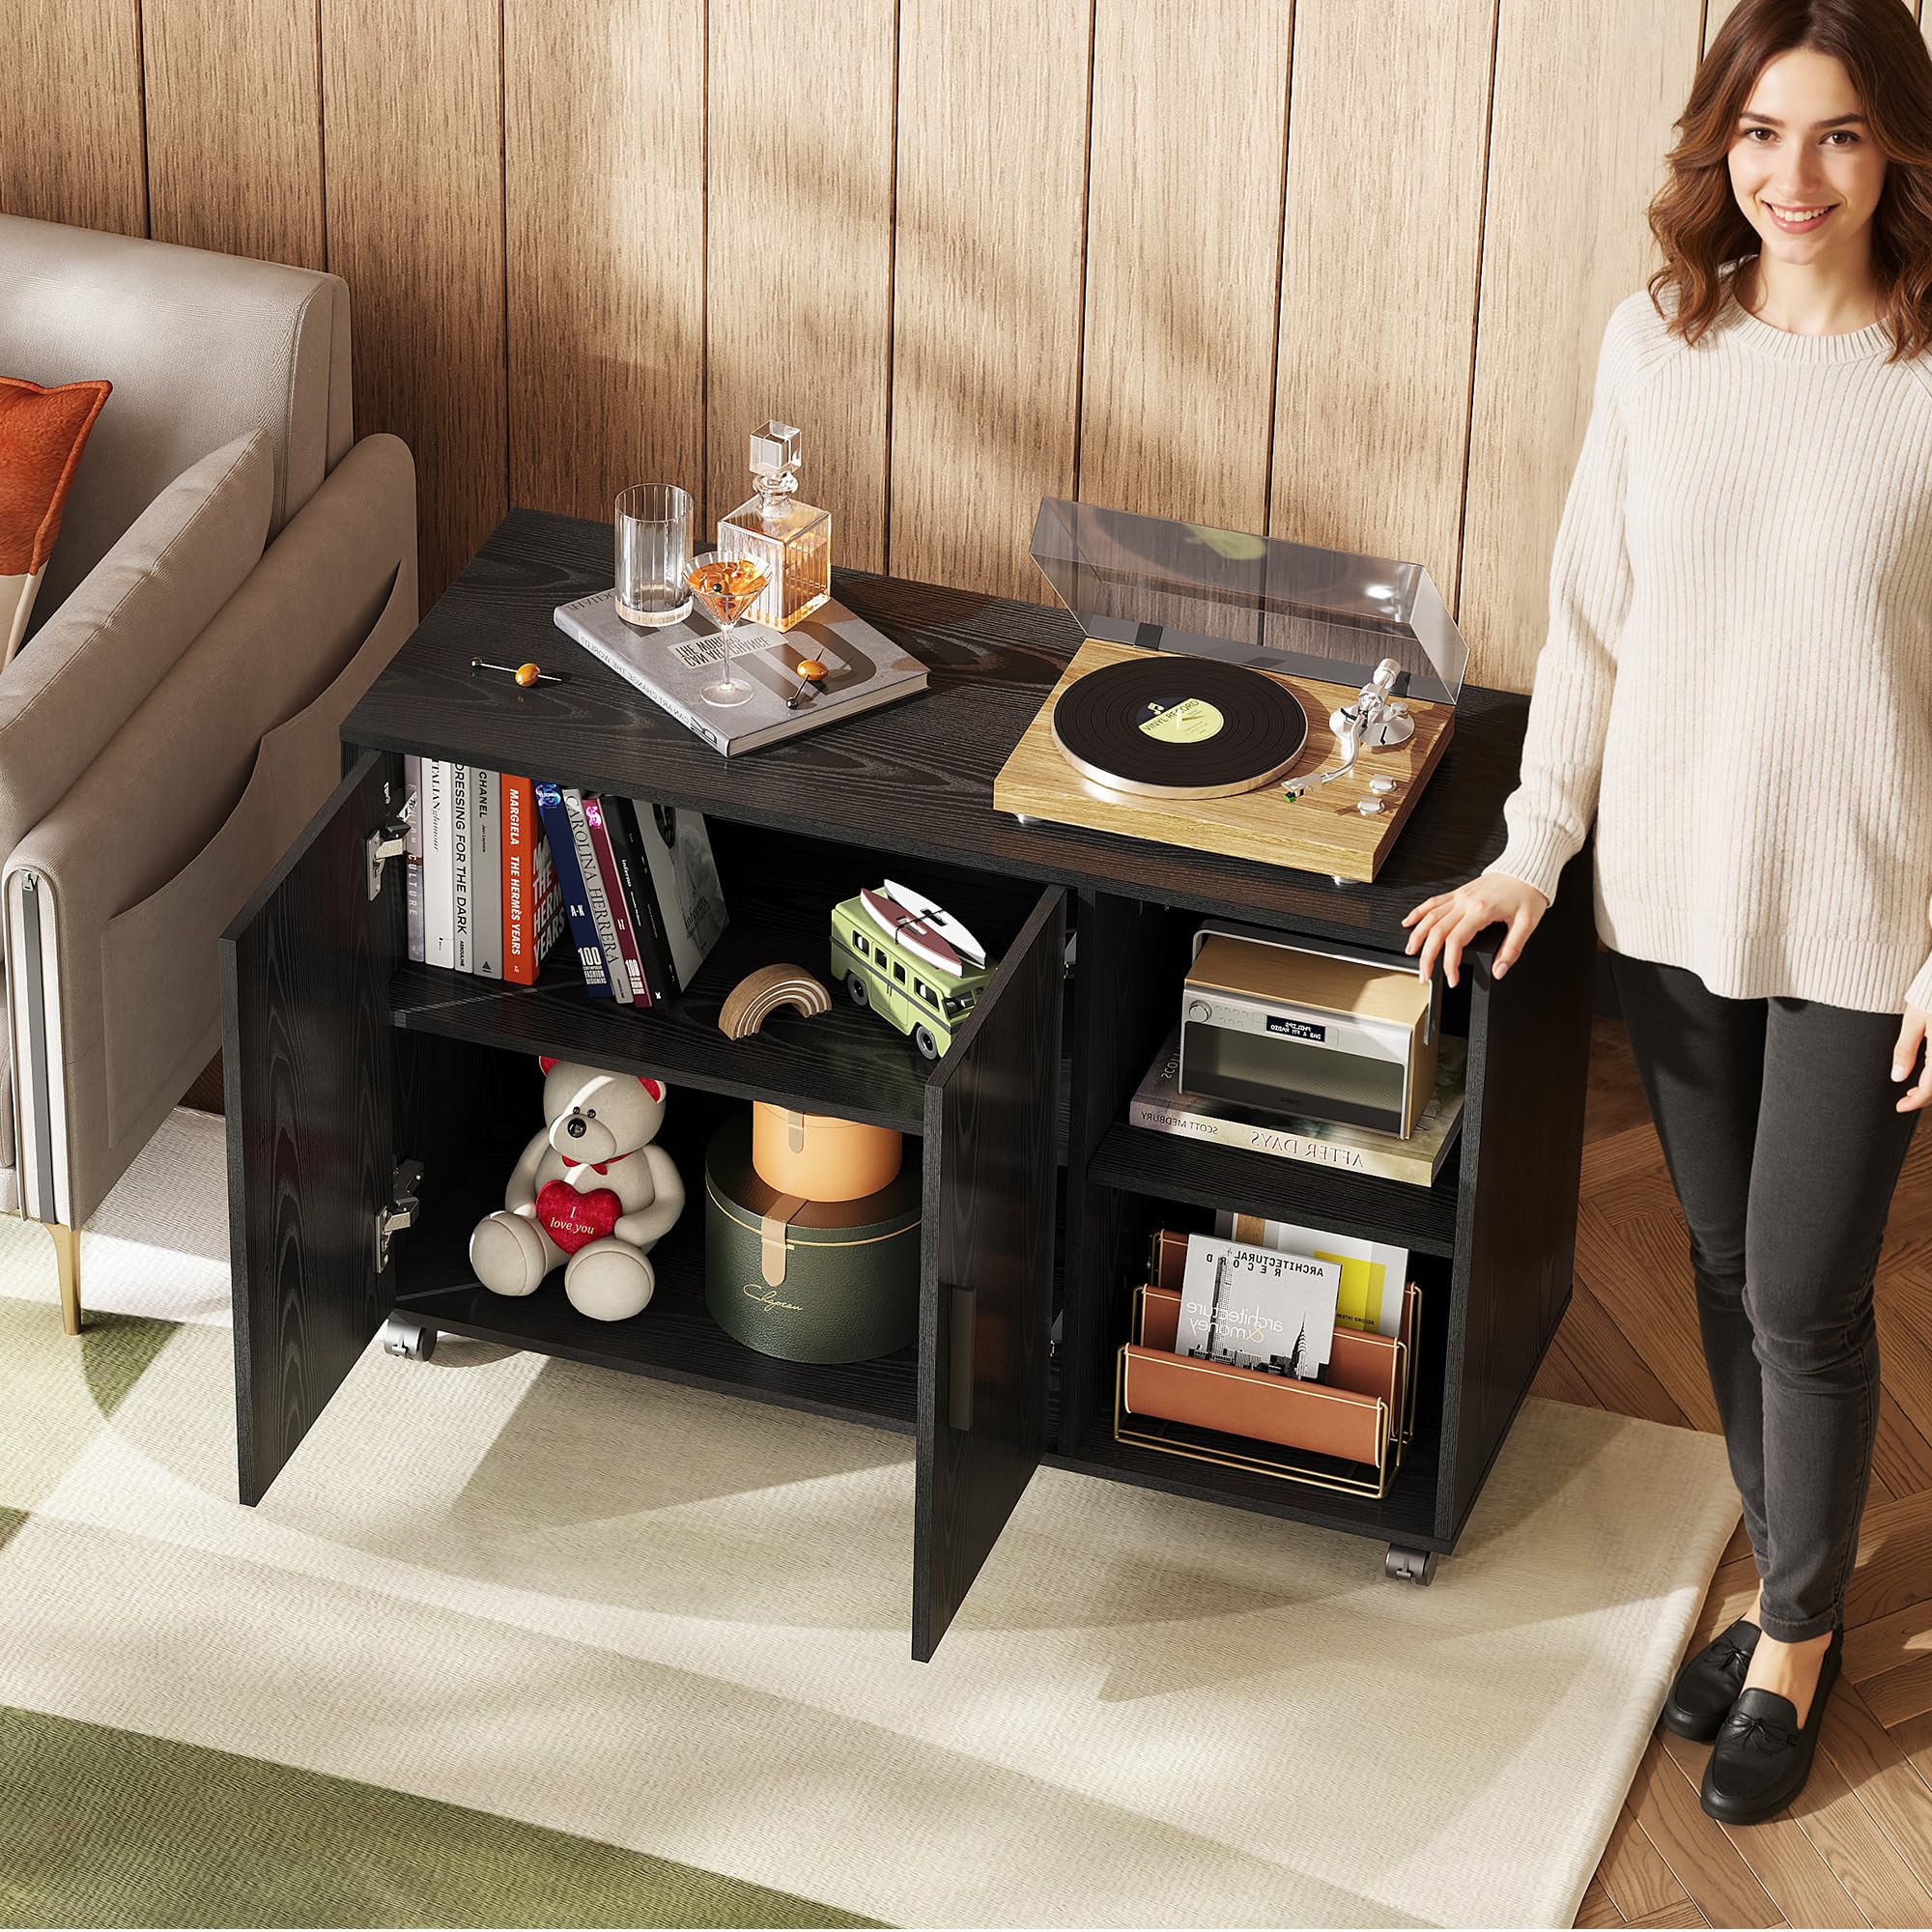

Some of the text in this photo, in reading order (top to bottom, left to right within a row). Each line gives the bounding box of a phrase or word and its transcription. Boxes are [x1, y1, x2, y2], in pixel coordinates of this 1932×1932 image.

[1142, 717, 1169, 731] VINYL
[478, 771, 488, 818] CHANEL
[509, 788, 520, 845] MARGIELA
[454, 763, 468, 935] DRESSING FOR THE DARK
[510, 856, 521, 877] THE
[409, 853, 418, 916] CULTURE
[510, 878, 522, 922] HERMÈS
[566, 795, 598, 880] CAROLINA
[588, 888, 619, 965] HERRERA
[533, 880, 562, 939] HERM
[511, 923, 521, 955] YEARS
[533, 907, 565, 967] YEARS
[578, 947, 602, 966] 100
[550, 1216, 595, 1235] love you
[570, 1207, 577, 1218] I
